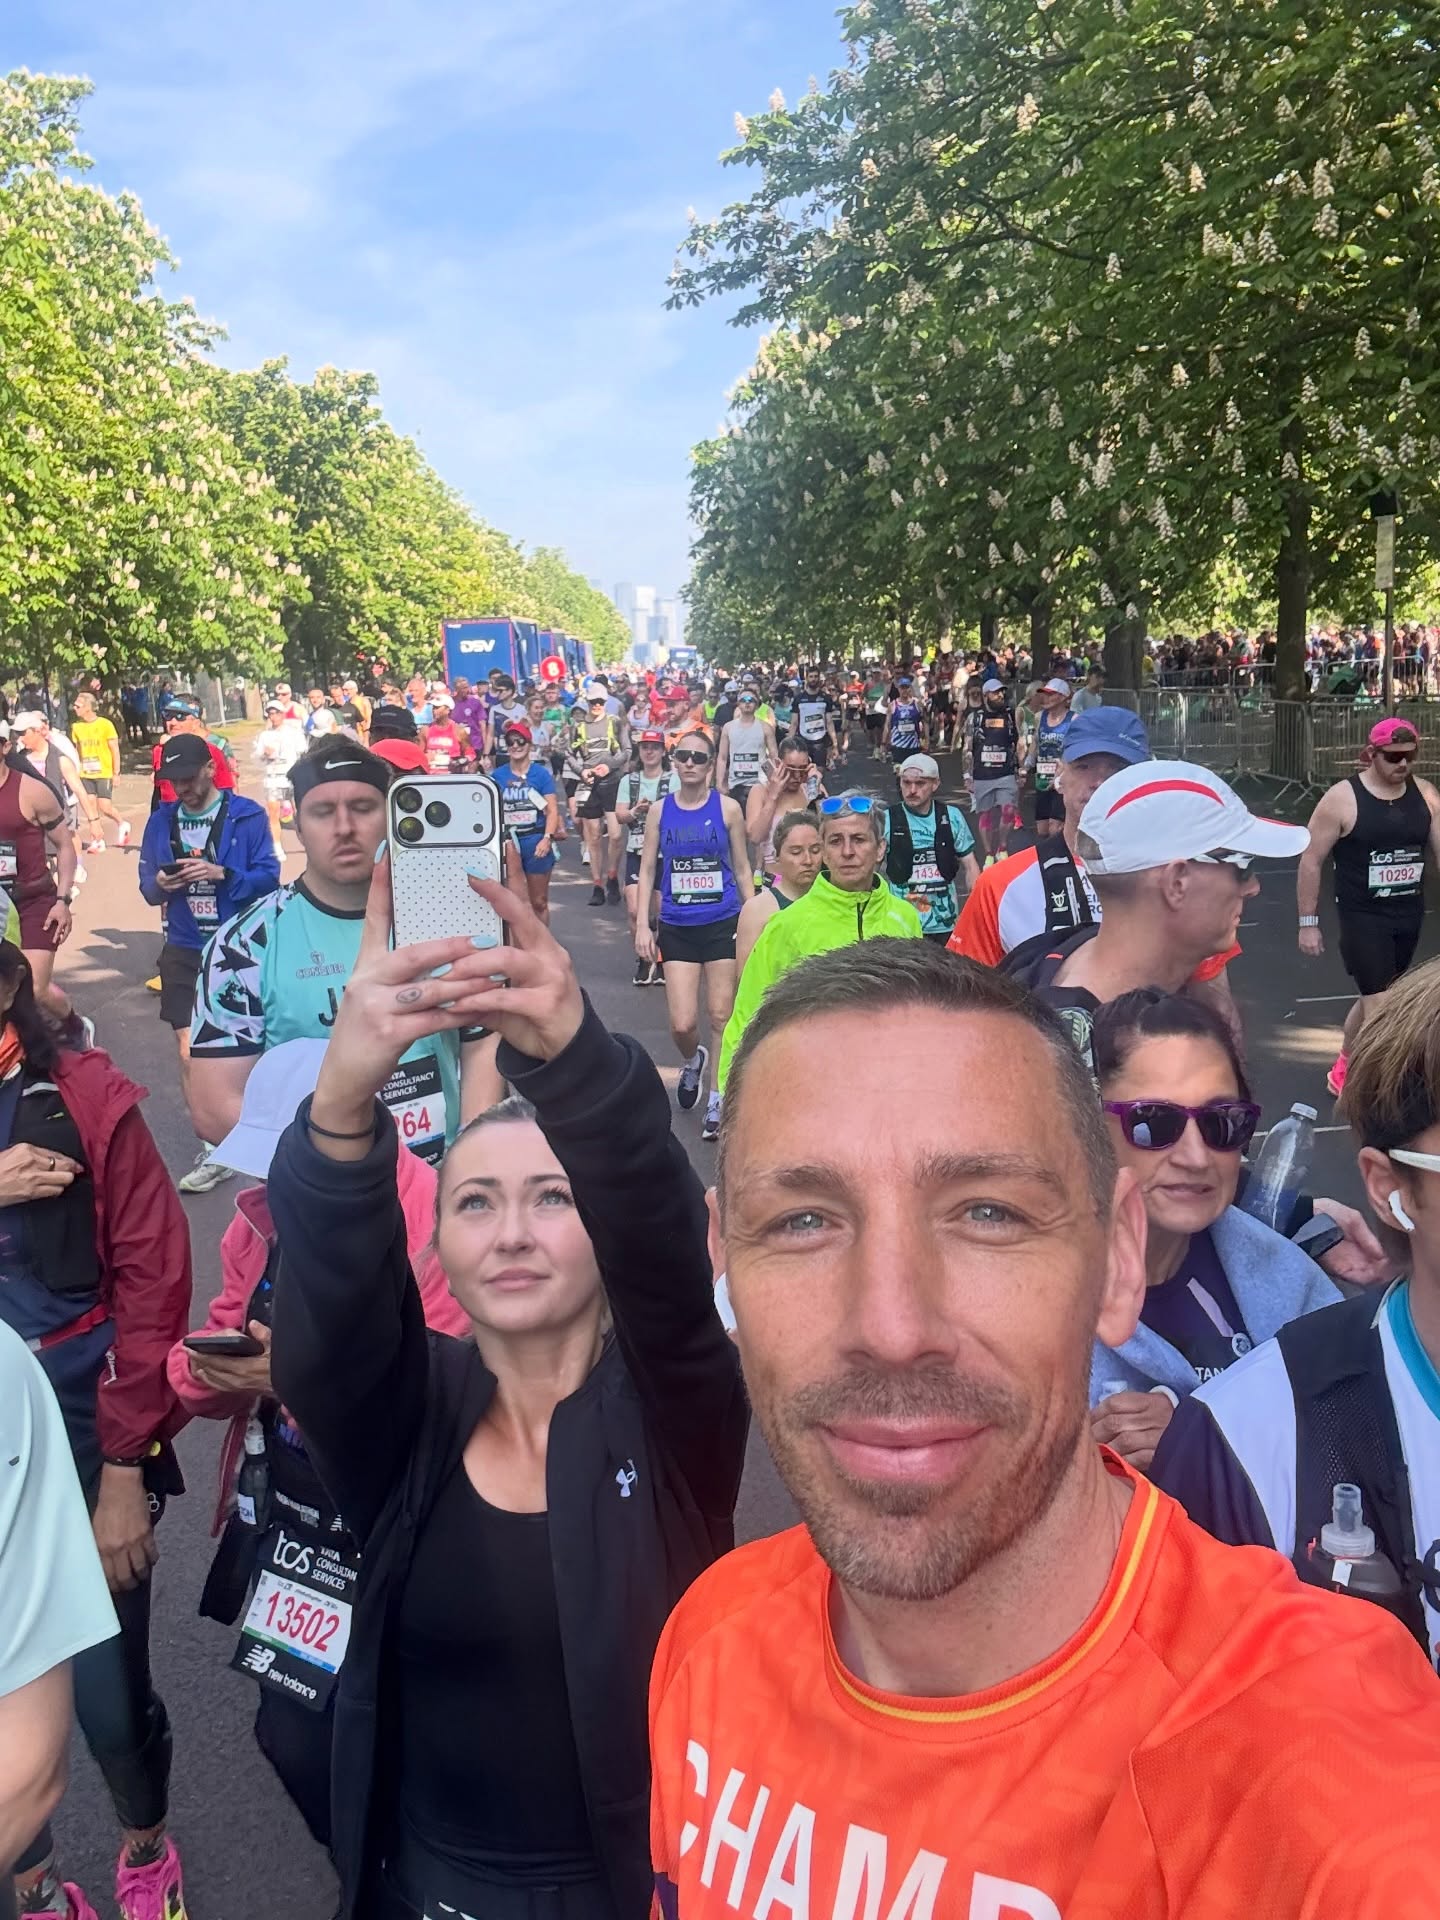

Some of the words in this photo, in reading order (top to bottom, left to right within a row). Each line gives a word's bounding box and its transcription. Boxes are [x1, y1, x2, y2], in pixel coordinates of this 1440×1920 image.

[459, 639, 496, 653] DSV
[547, 661, 560, 676] 8
[672, 859, 691, 870] tcs
[914, 868, 941, 879] 1434
[1379, 868, 1415, 882] 10292
[680, 876, 714, 889] 11603
[296, 963, 345, 979] CONQUER
[384, 1071, 434, 1091] CONSULTANCY
[383, 1085, 417, 1100] SERVICES
[273, 1530, 315, 1575] tcs
[320, 1546, 340, 1562] TATA
[311, 1569, 346, 1590] SERVICES
[265, 1590, 340, 1652] 13502
[267, 1668, 284, 1683] new
[283, 1673, 317, 1700] balance
